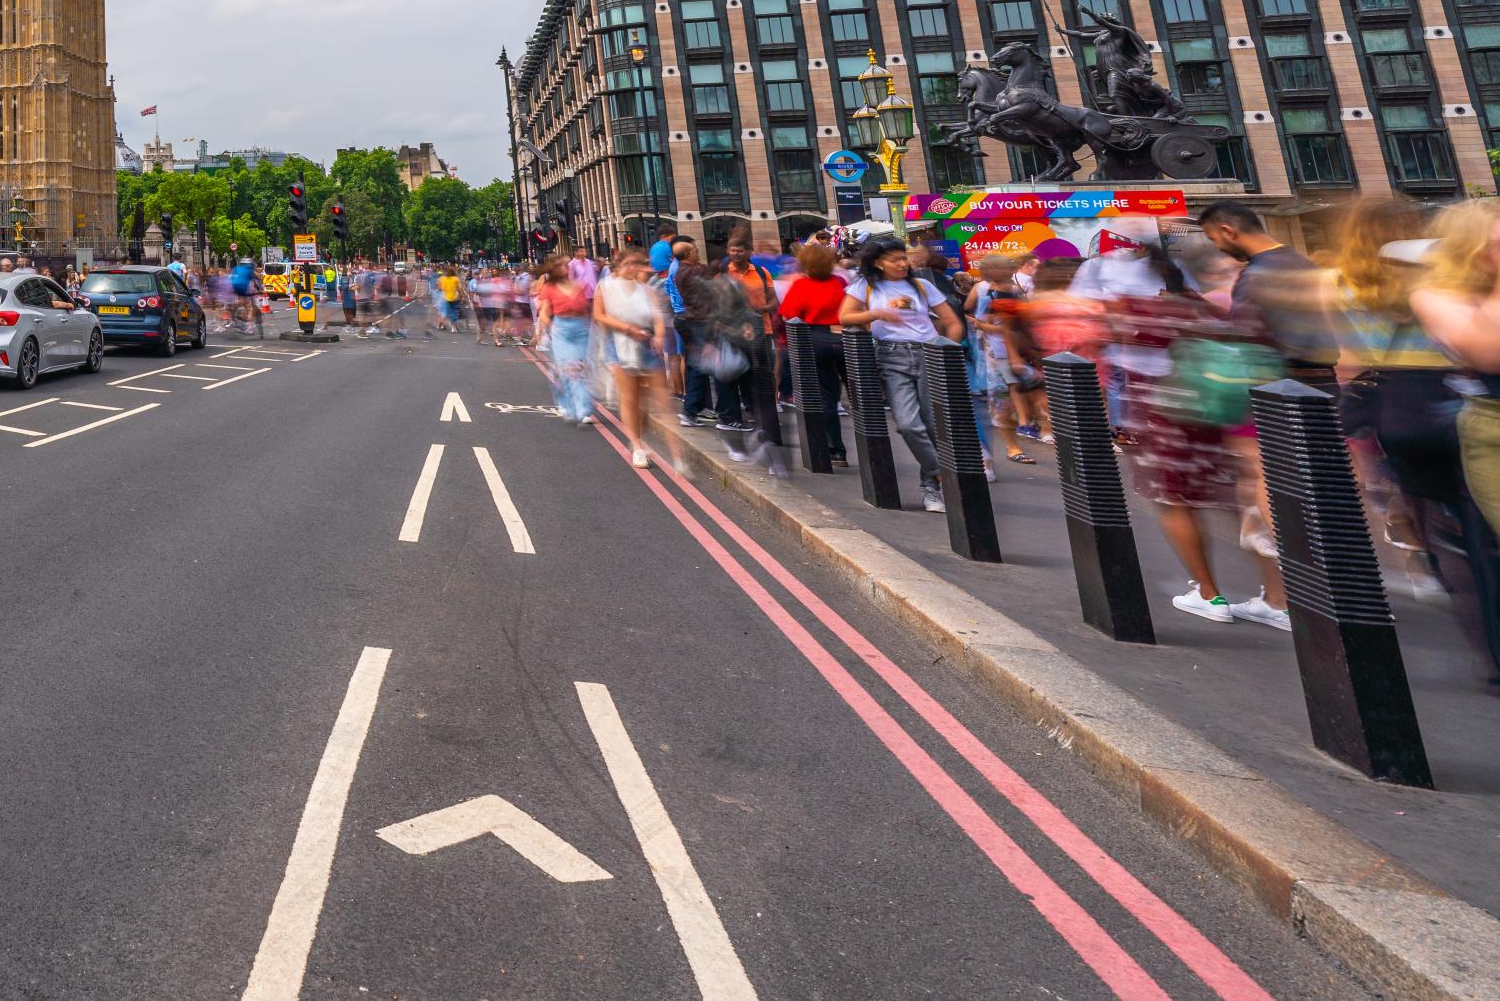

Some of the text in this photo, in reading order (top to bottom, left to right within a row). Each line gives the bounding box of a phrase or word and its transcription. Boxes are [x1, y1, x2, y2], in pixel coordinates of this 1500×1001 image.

[969, 201, 994, 210] BUY
[997, 200, 1032, 210] YOUR
[1035, 200, 1089, 209] TICKETS
[1093, 199, 1129, 208] HERE
[961, 224, 1024, 232] Hop On Hop Off
